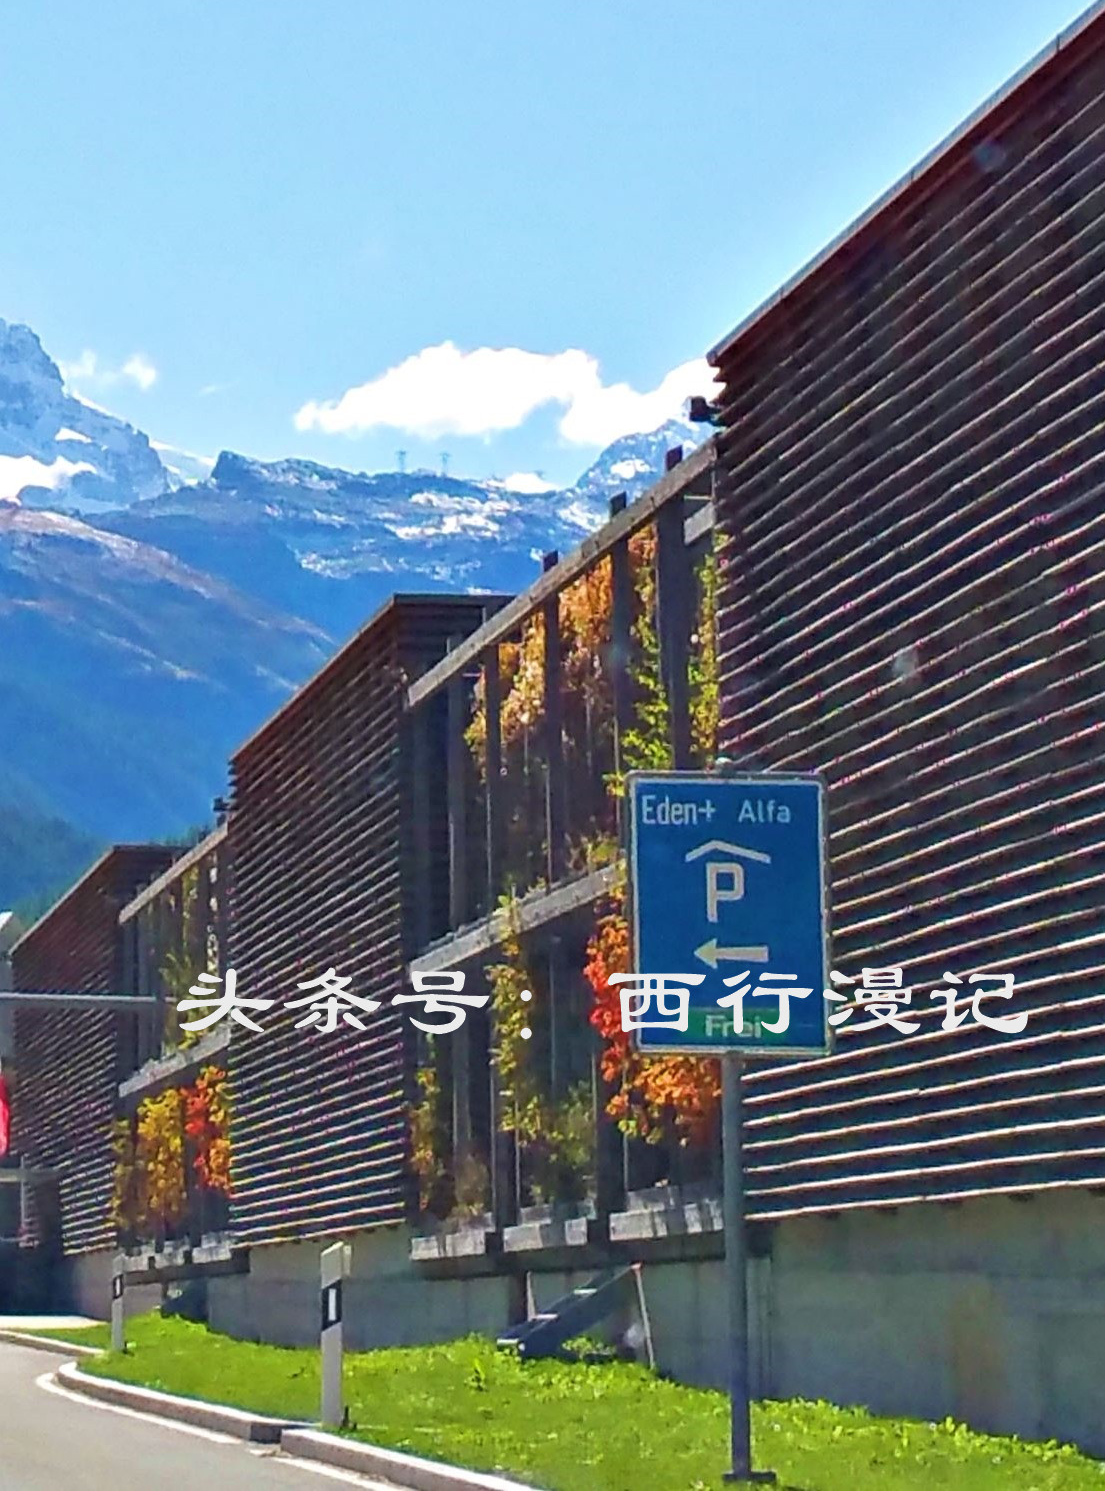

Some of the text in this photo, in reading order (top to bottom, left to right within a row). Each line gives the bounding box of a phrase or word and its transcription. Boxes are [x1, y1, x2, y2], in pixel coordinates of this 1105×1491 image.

[738, 799, 792, 825] Alfa
[705, 861, 745, 924] P
[705, 1014, 761, 1038] Frei
